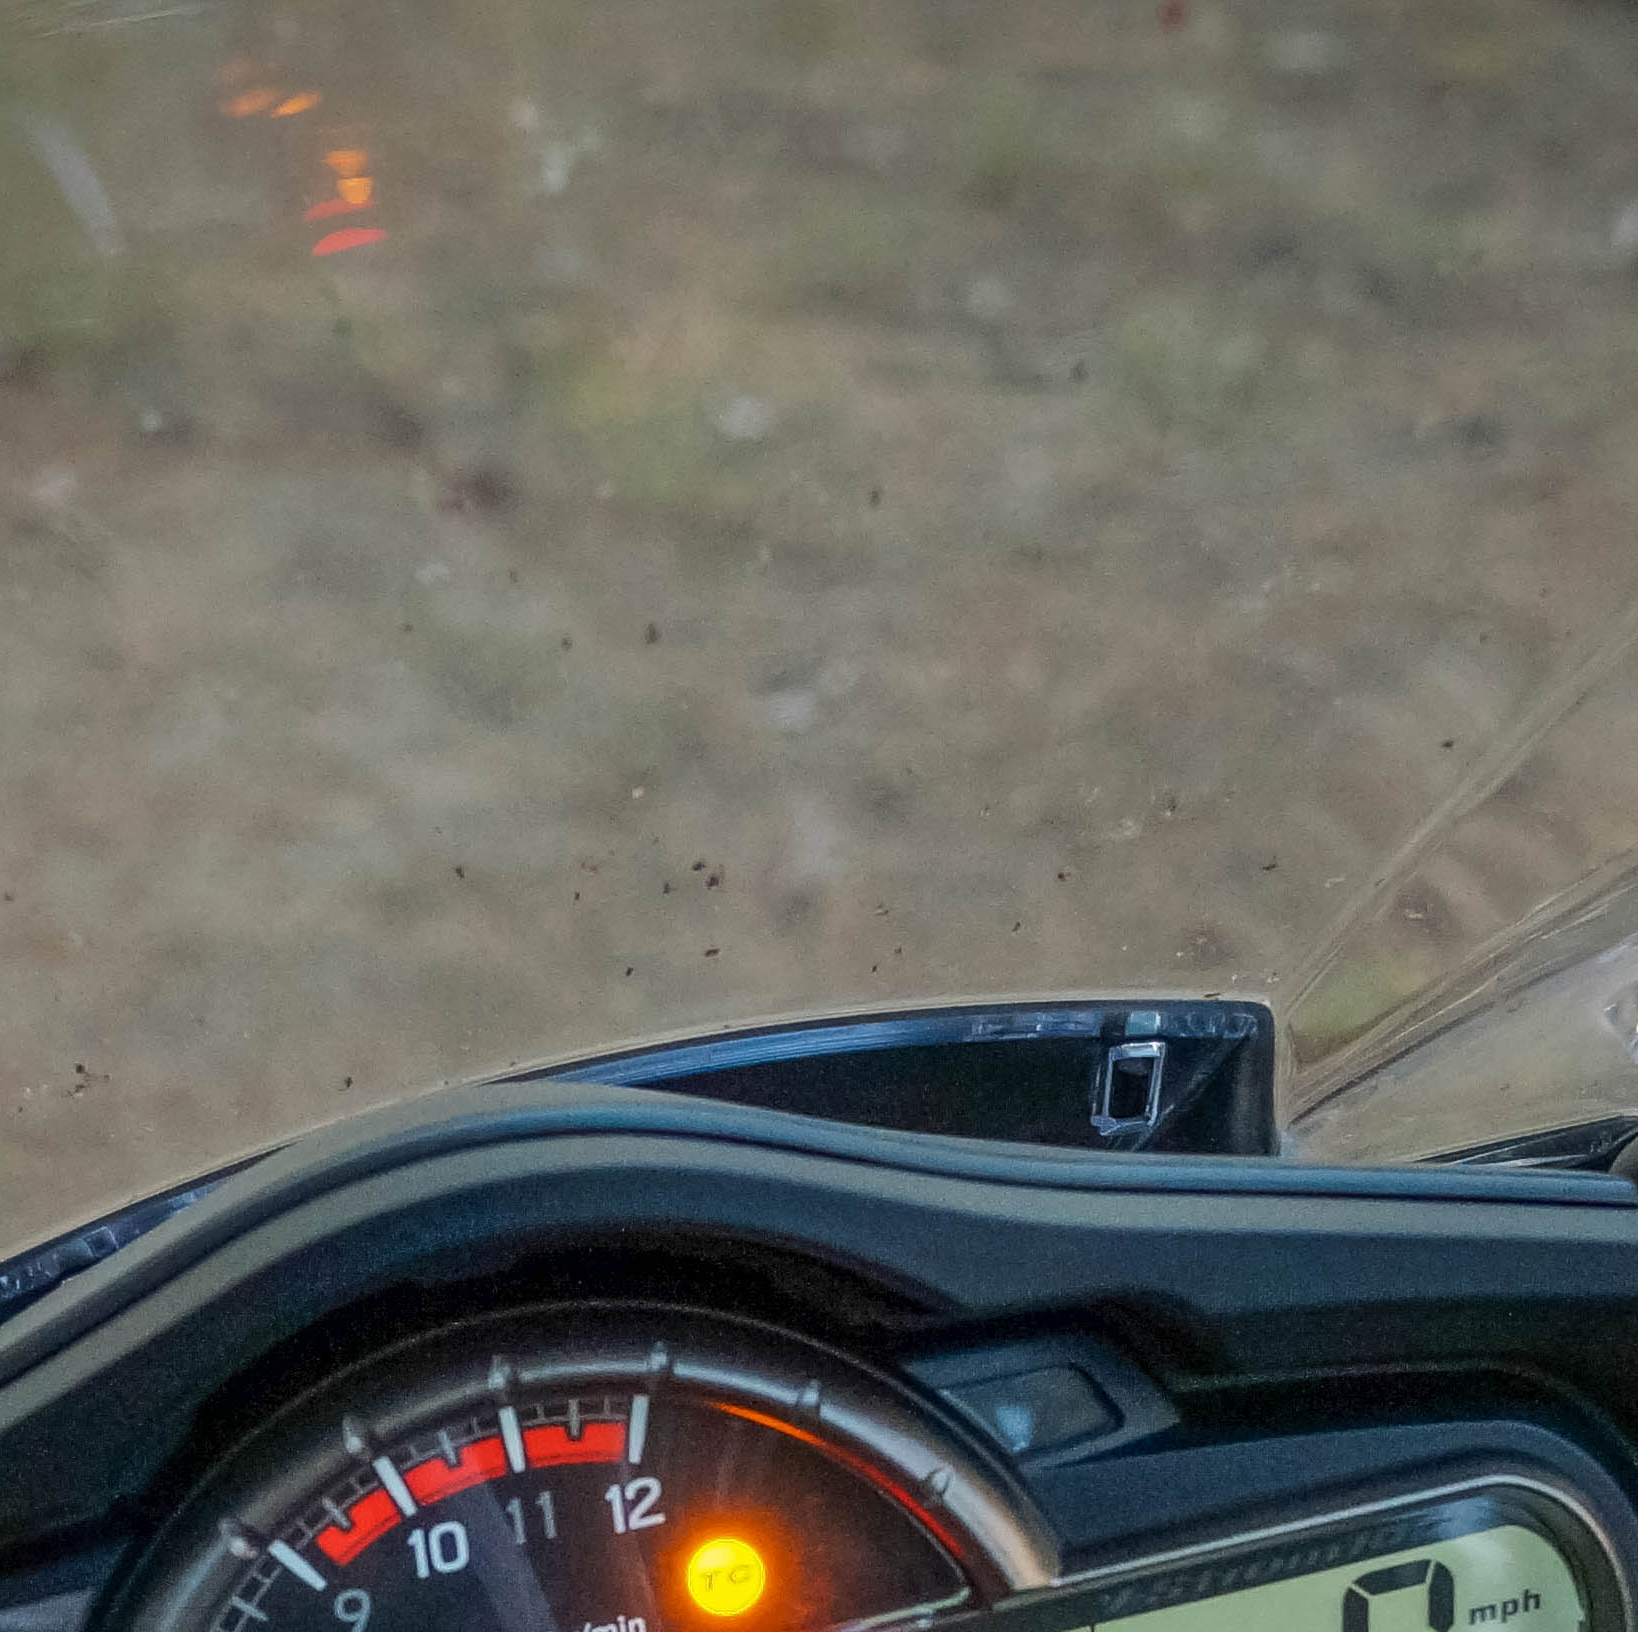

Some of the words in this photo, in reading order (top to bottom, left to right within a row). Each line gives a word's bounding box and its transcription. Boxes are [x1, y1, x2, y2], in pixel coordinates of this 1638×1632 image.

[506, 1491, 557, 1544] 11
[606, 1477, 665, 1533] 12
[407, 1521, 469, 1578] 10
[1468, 1588, 1542, 1628] mph
